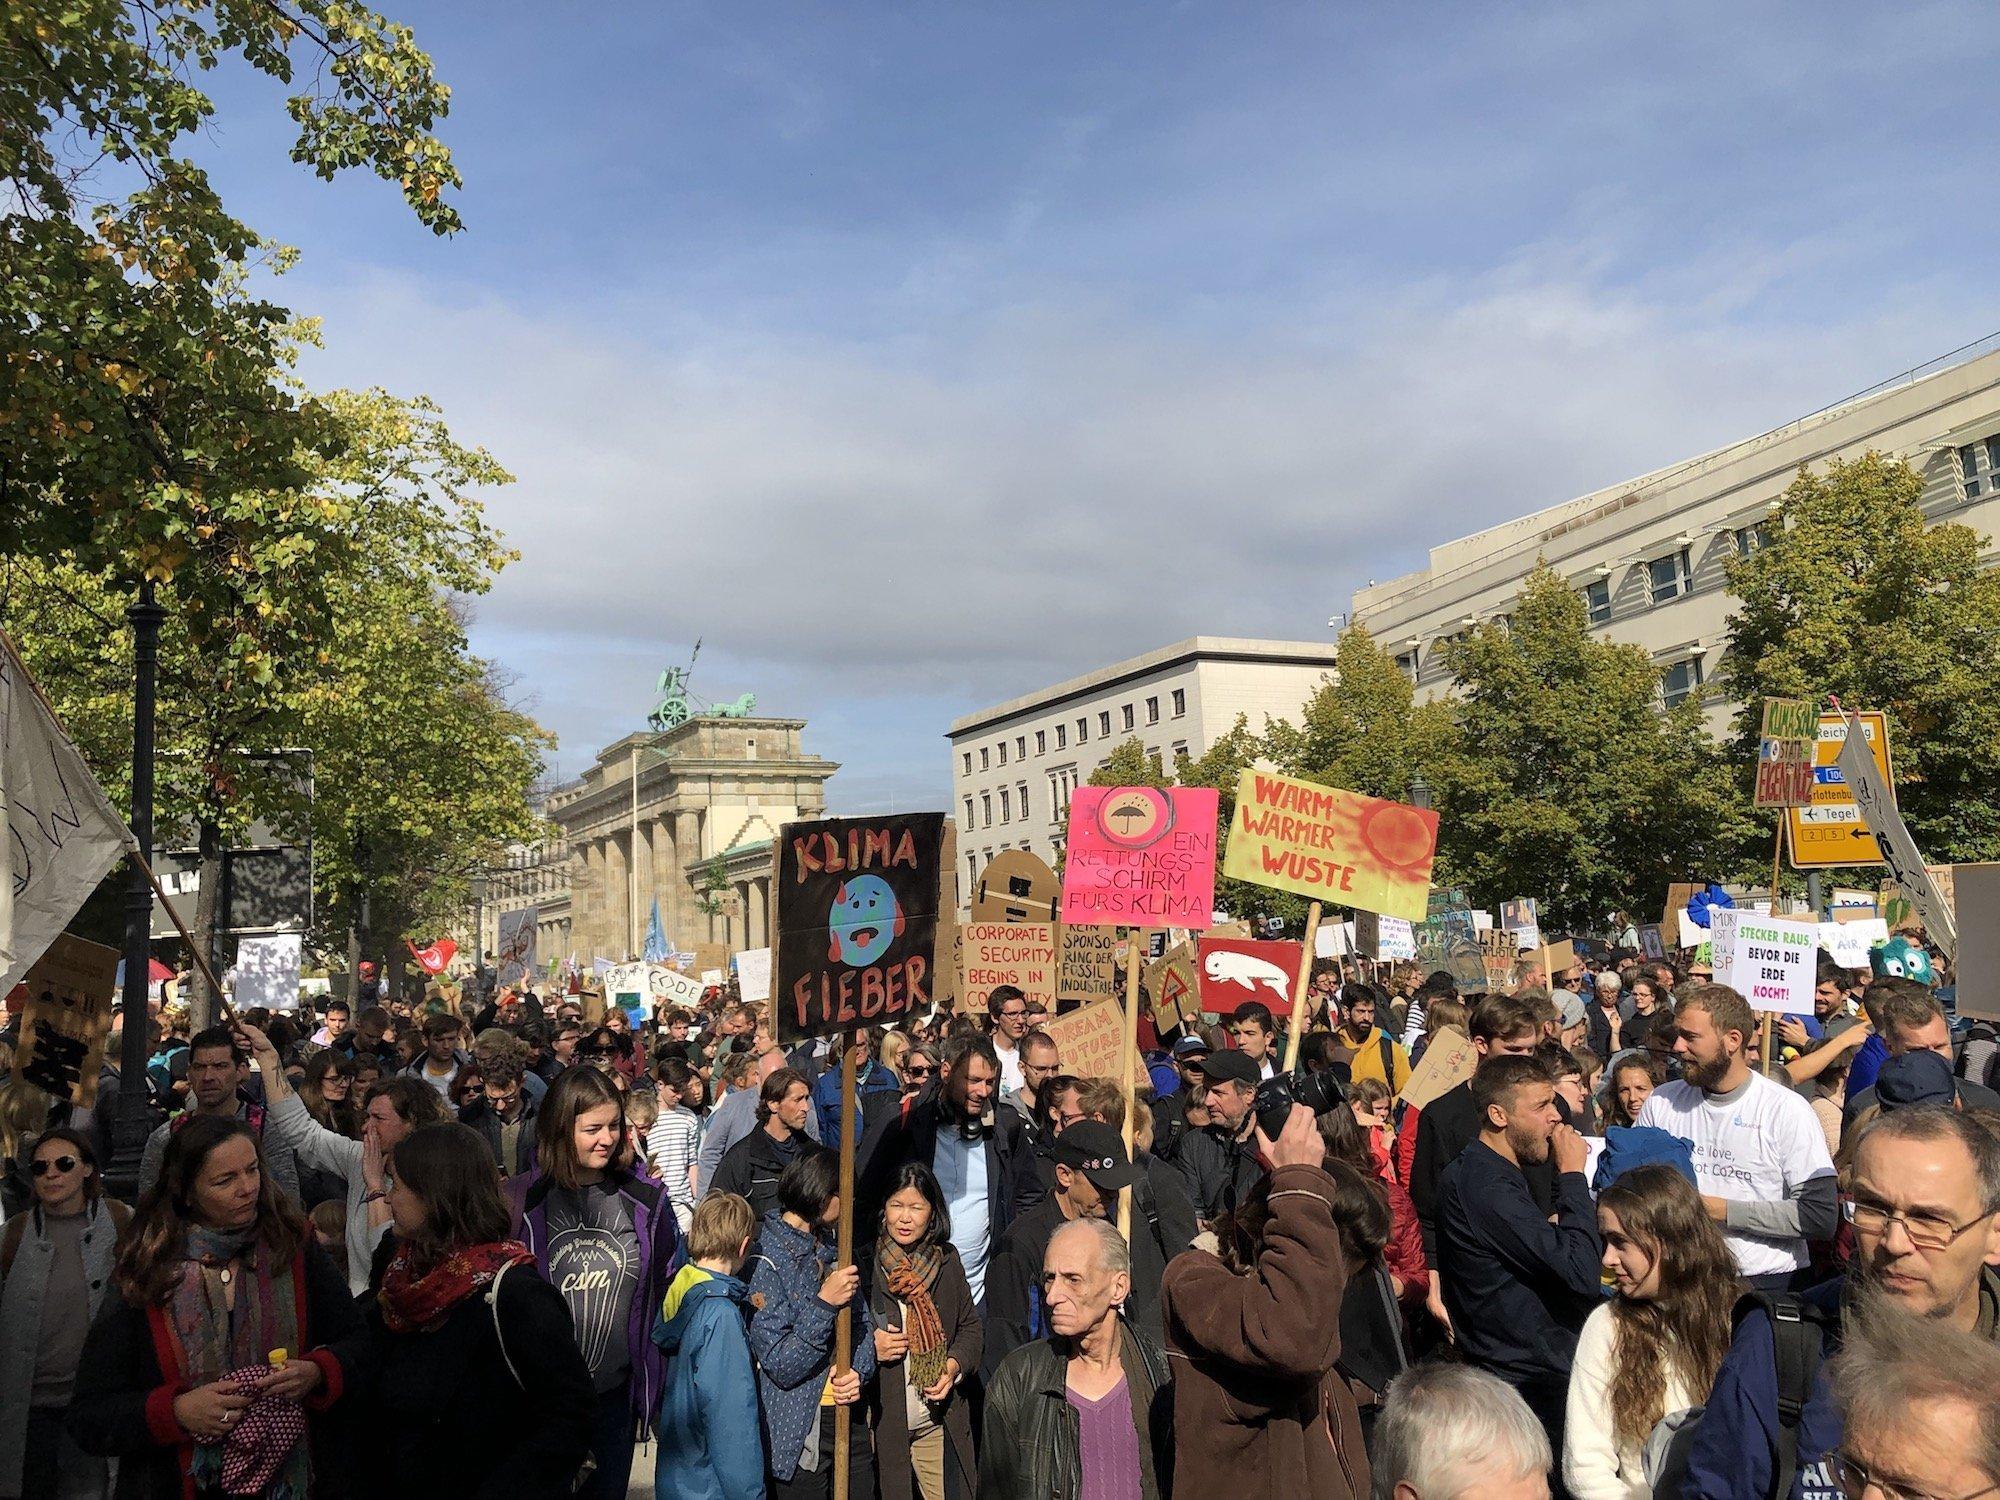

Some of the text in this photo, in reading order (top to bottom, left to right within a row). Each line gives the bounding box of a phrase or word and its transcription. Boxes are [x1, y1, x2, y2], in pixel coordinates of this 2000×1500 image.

[1818, 727, 1871, 739] Reichg
[1255, 775, 1333, 821] WARM
[1824, 808, 1856, 820] Tegel
[1242, 805, 1334, 851] WÄRMER
[1173, 831, 1209, 851] EIN
[793, 828, 918, 884] KLIMA
[1071, 849, 1205, 872] RETTUNGS-
[1262, 845, 1356, 892] WÜSTE
[1095, 868, 1186, 891] SCHIRM
[1069, 892, 1204, 916] FÜRS KLIMA
[967, 926, 1048, 942] CORPORATE
[1063, 933, 1116, 949] SPONSO-
[1740, 926, 1779, 944] STECKER
[1783, 931, 1812, 948] RAUS,
[980, 946, 1055, 963] SECURITY
[1065, 951, 1113, 964] RING DER
[1748, 947, 1800, 964] BEVOR DIE
[969, 969, 1043, 984] BEGINS IN
[1062, 963, 1105, 979] FOSSIL
[1761, 968, 1785, 981] ERDE
[793, 955, 930, 1027] FIEBER
[1061, 978, 1115, 995] INDUSTRIE
[1753, 985, 1790, 1000] KOCHT!
[1051, 1008, 1113, 1048] DREAM
[1077, 1050, 1117, 1080] NOT
[1708, 1145, 1735, 1163] love,
[1694, 1163, 1752, 1184] ot Co2eq
